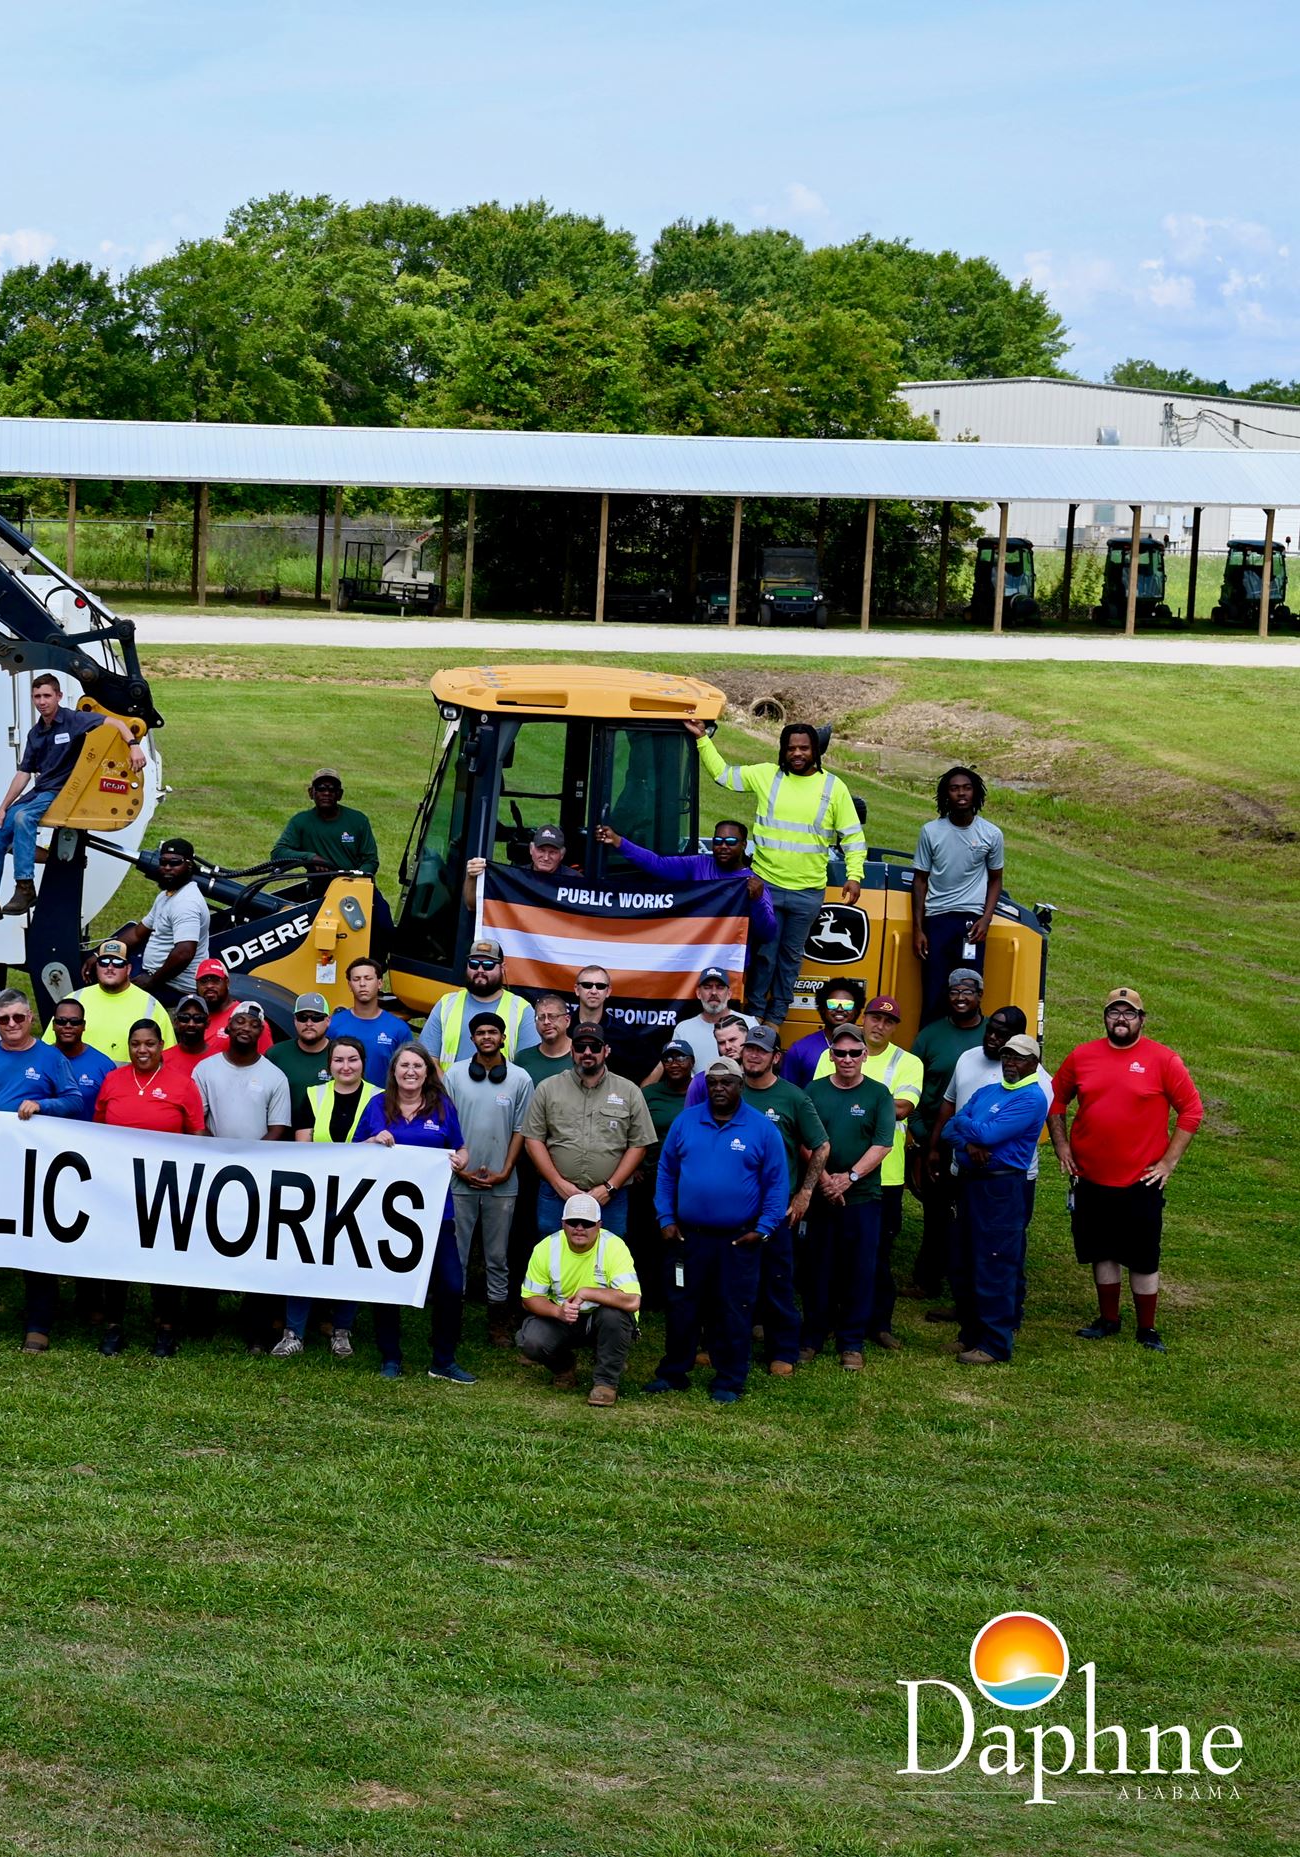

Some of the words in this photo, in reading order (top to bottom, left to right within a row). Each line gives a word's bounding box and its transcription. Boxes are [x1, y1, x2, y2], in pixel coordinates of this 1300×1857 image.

[556, 887, 614, 907] PUBLIC
[618, 892, 675, 909] WORKS
[220, 914, 313, 970] DEERE
[605, 1007, 677, 1026] SPONDER
[133, 1157, 425, 1273] WORKS
